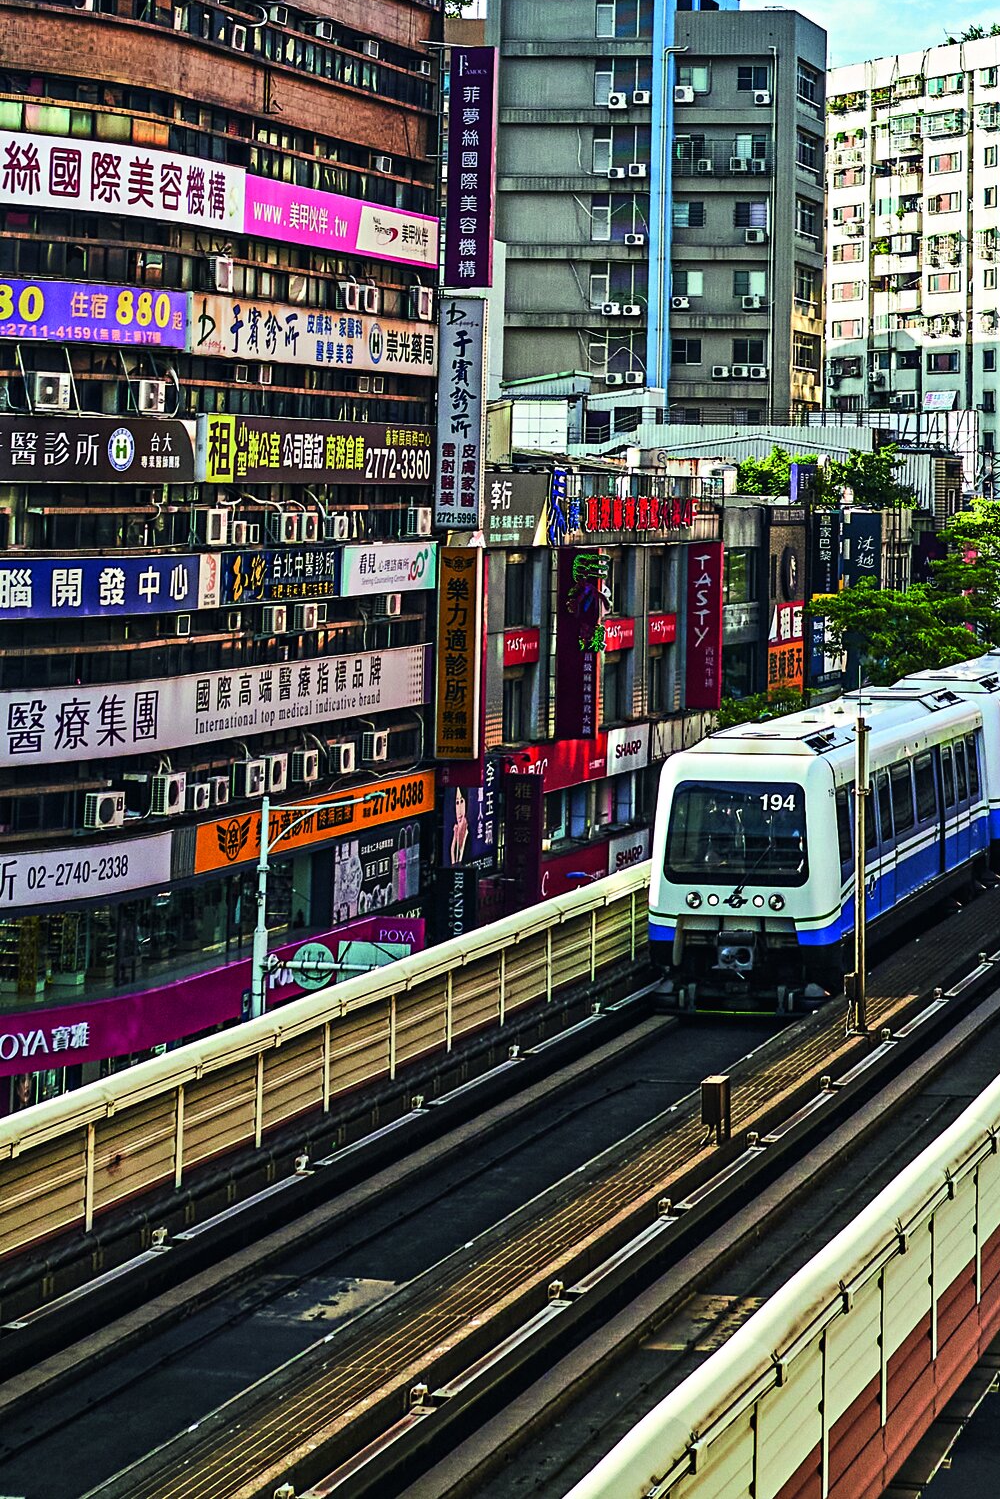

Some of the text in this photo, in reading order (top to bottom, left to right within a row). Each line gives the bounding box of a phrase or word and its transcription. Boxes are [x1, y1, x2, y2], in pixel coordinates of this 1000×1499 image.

[3, 140, 226, 220] 絲國際美容機構
[458, 86, 480, 278] 菲夢絲國際美容機構
[70, 292, 108, 319] 住宿
[115, 290, 171, 328] 880
[386, 330, 433, 365] 崇光藥局
[0, 432, 100, 466] 醫診所
[151, 432, 173, 452] 台大
[209, 421, 231, 477] 租
[283, 433, 324, 469] 公司登記
[326, 434, 365, 470] 商務倉庫
[365, 447, 430, 480] 2772-3360
[437, 513, 477, 524] 2721-5996
[273, 551, 335, 579] 台北中醫診所
[0, 564, 188, 608] 腦開發中心
[694, 554, 712, 648] TASTY
[446, 578, 469, 702] 樂力適診所
[195, 656, 382, 713] 國際高端醫療指標品牌
[7, 689, 159, 755] 醫療集團
[195, 689, 382, 735] International top medical indicative brand
[615, 739, 642, 759] SHARP
[372, 783, 424, 816] 2773-0388
[760, 794, 796, 811] 194
[28, 854, 129, 890] 02-2740-2338
[615, 845, 643, 868] SHARP
[454, 872, 464, 918] BRAND
[379, 929, 416, 943] POYA
[52, 1022, 90, 1052] 寶雅
